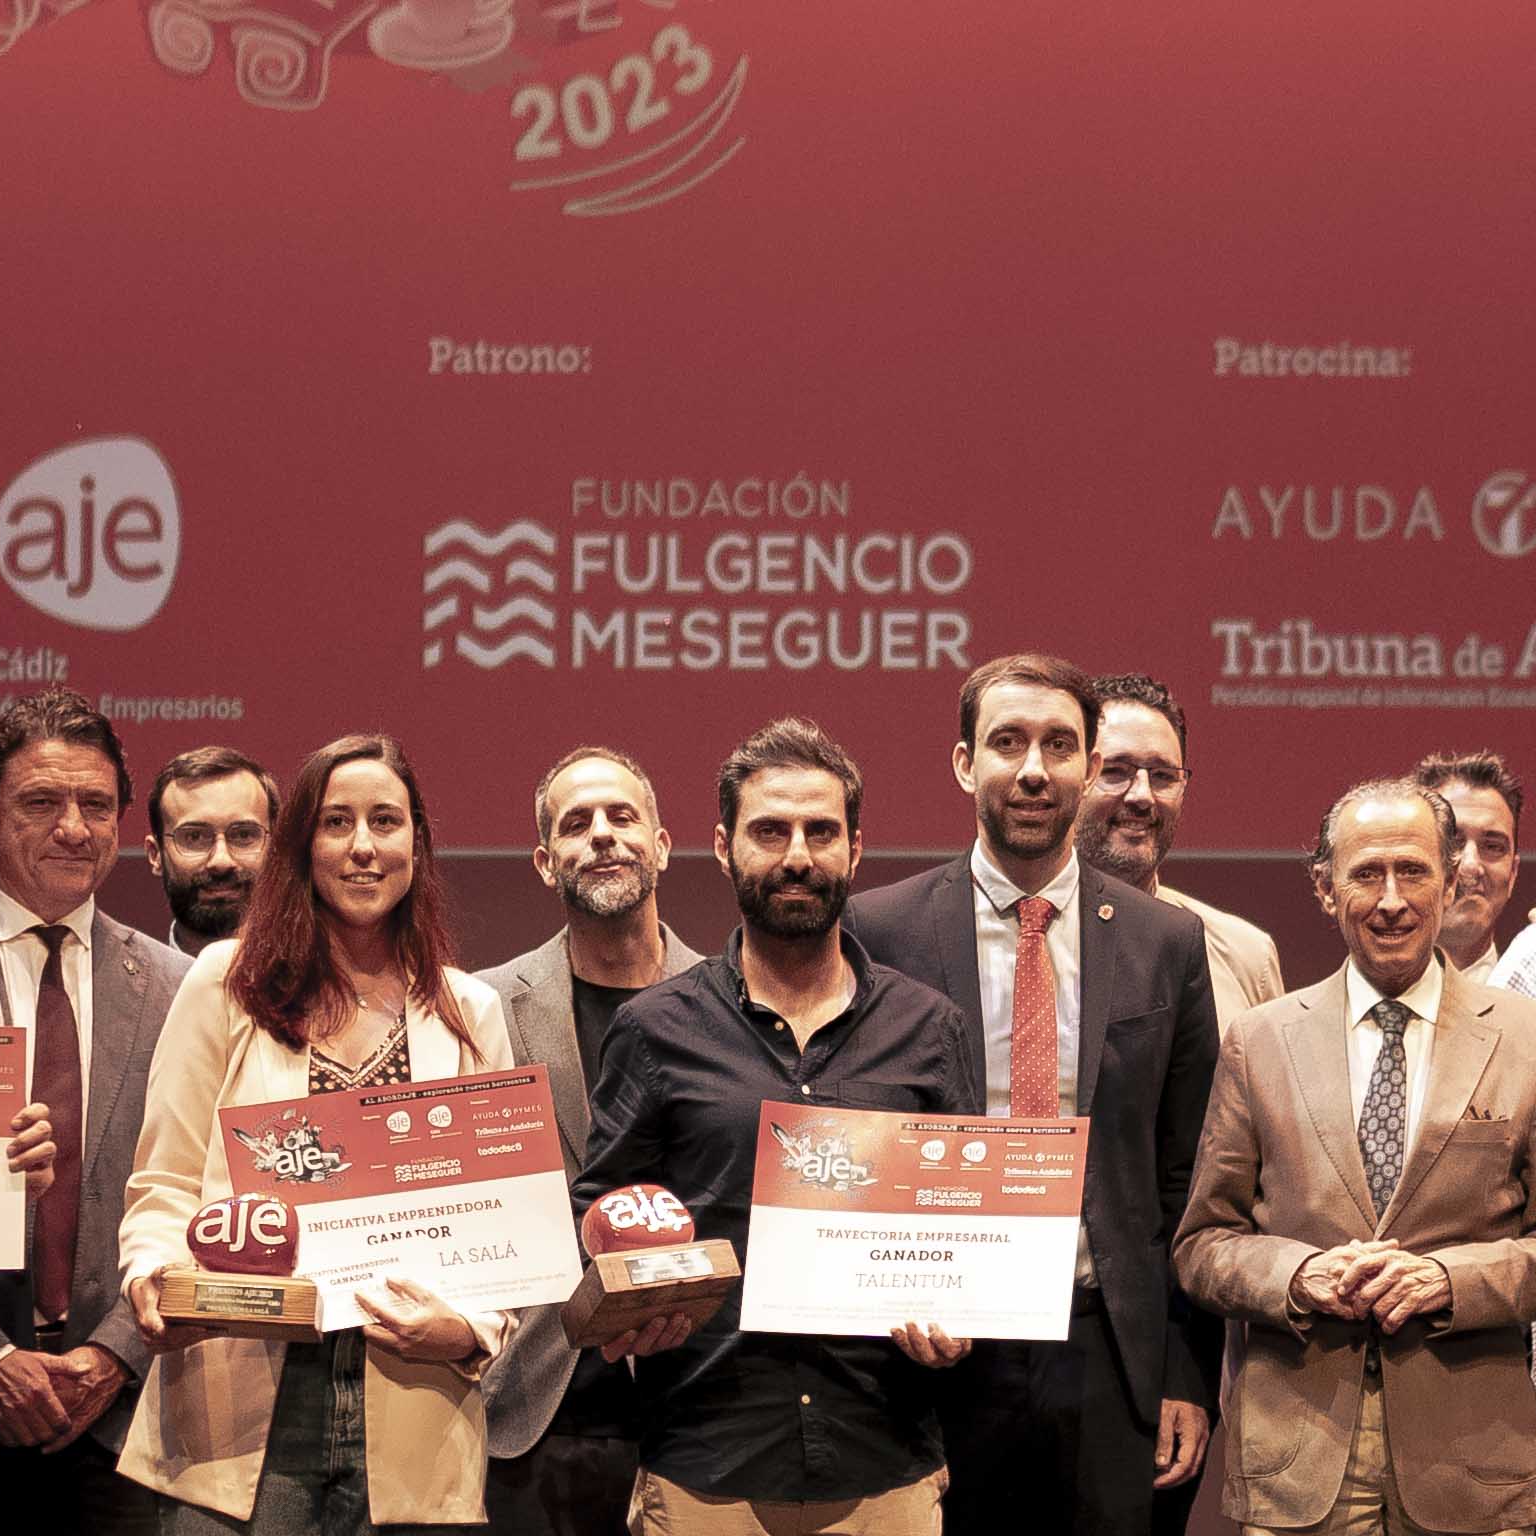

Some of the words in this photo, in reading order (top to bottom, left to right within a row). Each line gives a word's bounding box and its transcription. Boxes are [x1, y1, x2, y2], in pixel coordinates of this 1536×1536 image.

[508, 26, 714, 163] 2023
[428, 337, 593, 376] Patrono:
[1213, 338, 1412, 379] Patrocina:
[571, 472, 852, 520] FUNDACIÓN
[1210, 484, 1446, 542] AYUDA
[5, 475, 164, 596] aje
[571, 534, 973, 595] FULGENCIO
[571, 609, 974, 672] MESEGUER
[1211, 617, 1444, 678] Tribuna
[1453, 632, 1506, 678] de
[98, 693, 244, 723] Empresarios
[429, 1109, 450, 1124] aje
[276, 1146, 325, 1177] aje
[411, 1158, 461, 1172] FULGENCIO
[413, 1167, 462, 1181] MESEGUER
[801, 1153, 851, 1182] aje
[195, 1201, 288, 1252] aje
[307, 1214, 385, 1233] INICIATIVA
[389, 1198, 503, 1223] EMPRENDEDORA
[600, 1186, 692, 1232] aje
[816, 1228, 912, 1241] TRAYECTORIA
[916, 1231, 1011, 1244] EMPRESARIAL
[439, 1250, 465, 1267] LA
[869, 1249, 954, 1262] GANADOR
[329, 1272, 374, 1286] GANADOR
[855, 1272, 964, 1289] TALENTUM
